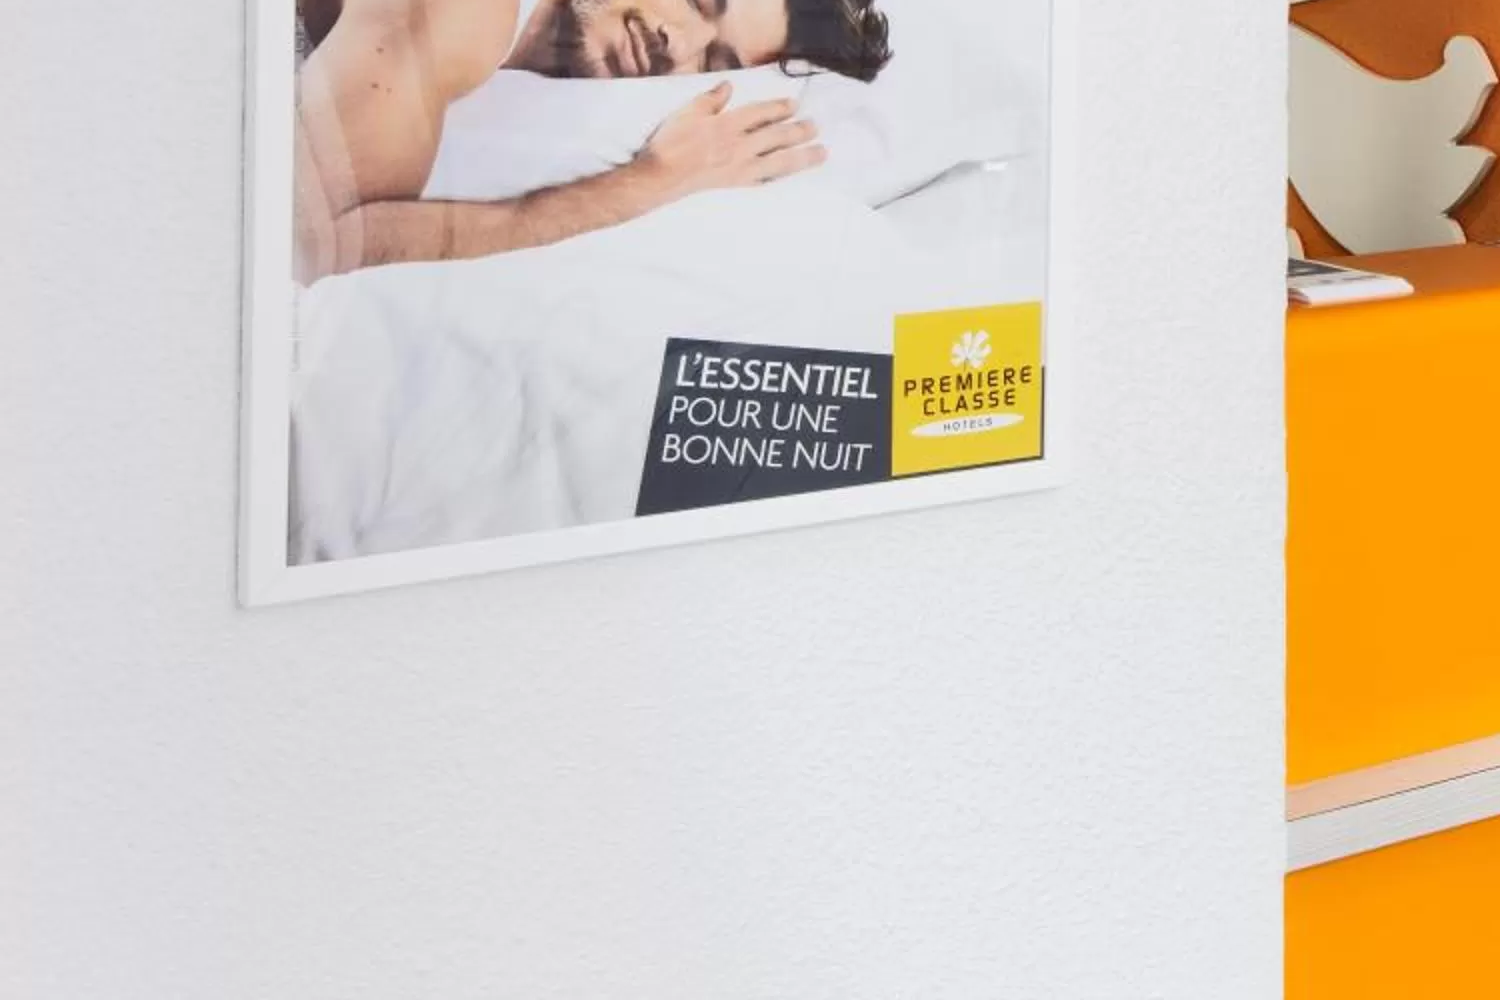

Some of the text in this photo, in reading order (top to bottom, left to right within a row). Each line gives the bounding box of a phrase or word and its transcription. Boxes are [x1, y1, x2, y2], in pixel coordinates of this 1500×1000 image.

[676, 352, 878, 399] L'ESSENTIEL
[903, 365, 1033, 398] PREMIERE
[669, 395, 841, 433] POUR UNE
[923, 388, 1017, 417] CLASSE
[943, 417, 994, 433] HOTELS
[661, 433, 873, 472] BONNE NUIT
